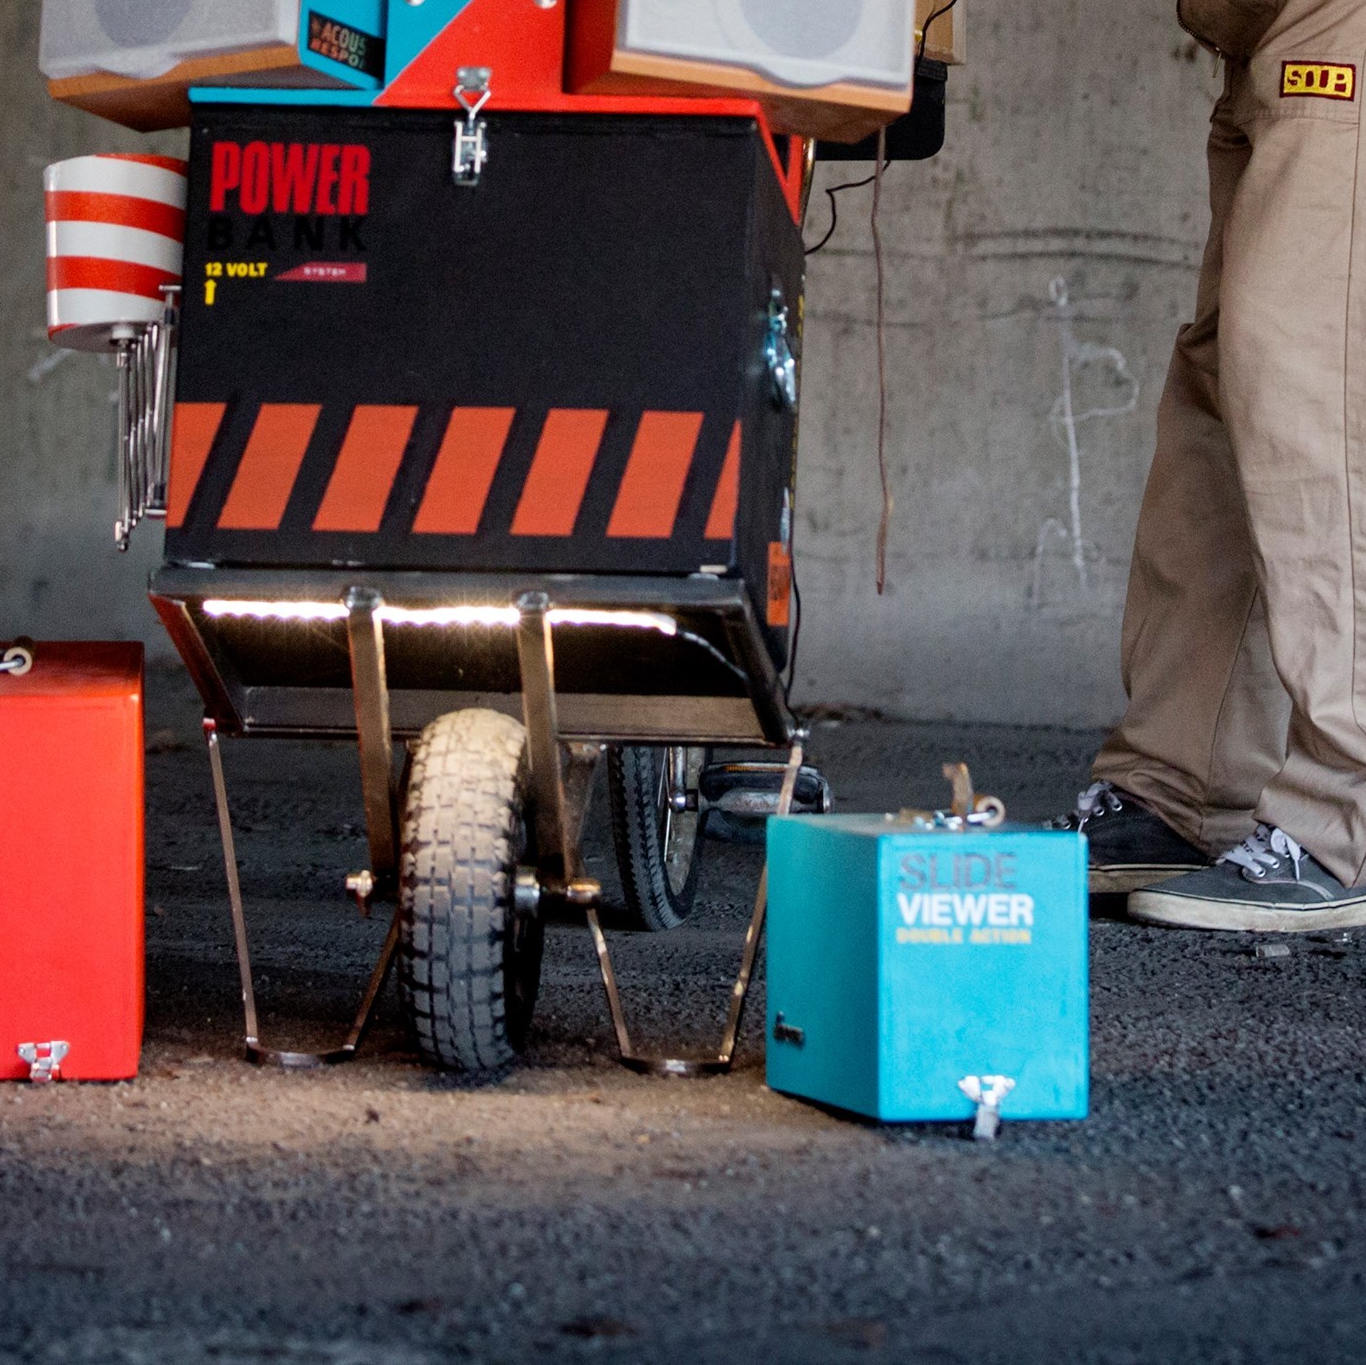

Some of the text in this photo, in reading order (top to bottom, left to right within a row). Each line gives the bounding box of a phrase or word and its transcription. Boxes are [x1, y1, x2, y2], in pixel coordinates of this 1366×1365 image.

[209, 140, 372, 215] POWER
[207, 215, 368, 251] BANK
[204, 261, 269, 277] 12 VOLT
[899, 852, 1017, 890] SLIDE
[897, 893, 1035, 926] VIEWER
